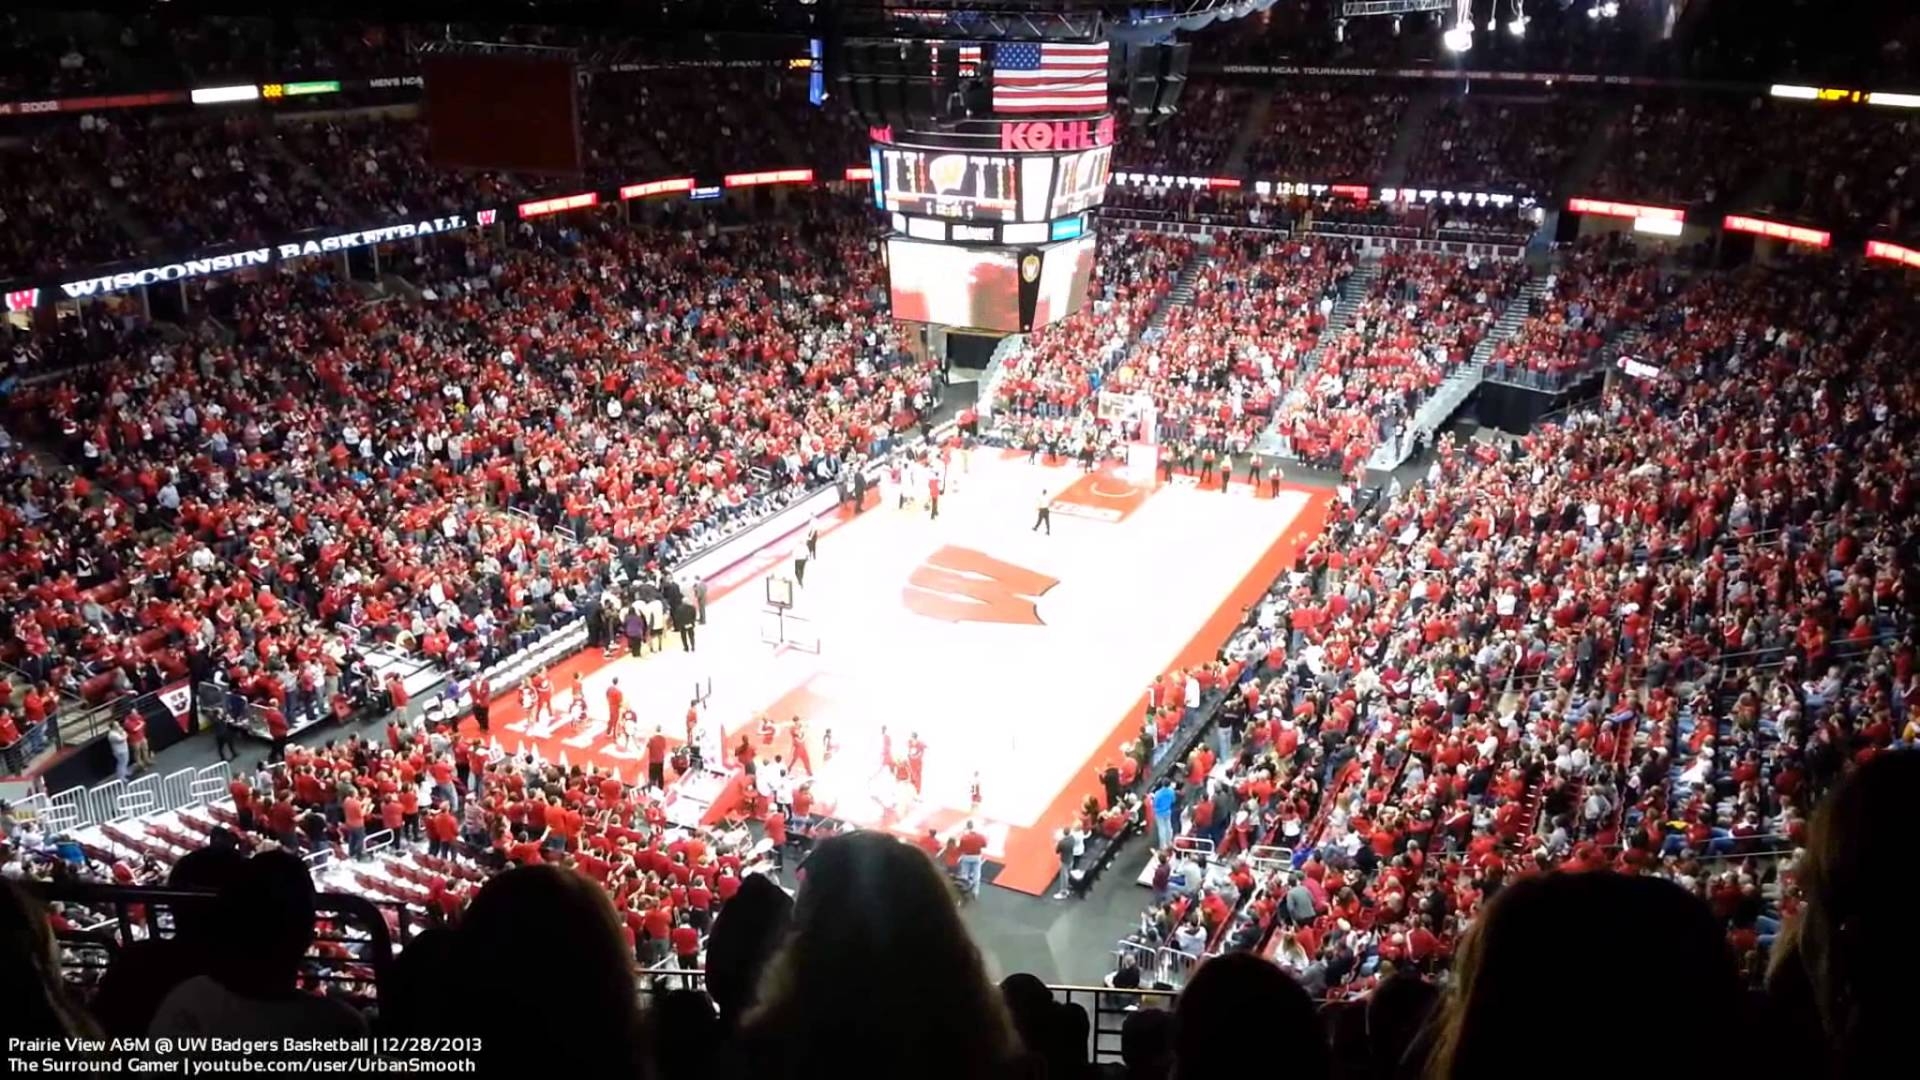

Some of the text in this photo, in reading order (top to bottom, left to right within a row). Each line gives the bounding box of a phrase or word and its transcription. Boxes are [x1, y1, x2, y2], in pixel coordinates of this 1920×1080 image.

[1223, 65, 1269, 75] WOMEN'S
[1271, 66, 1300, 76] NCAA
[1302, 66, 1377, 77] TOURNAMENT
[369, 77, 400, 88] MEN'S
[1276, 182, 1310, 197] 12:01
[61, 215, 468, 298] WISCONSIN BASKETBALL
[5, 288, 40, 312] W
